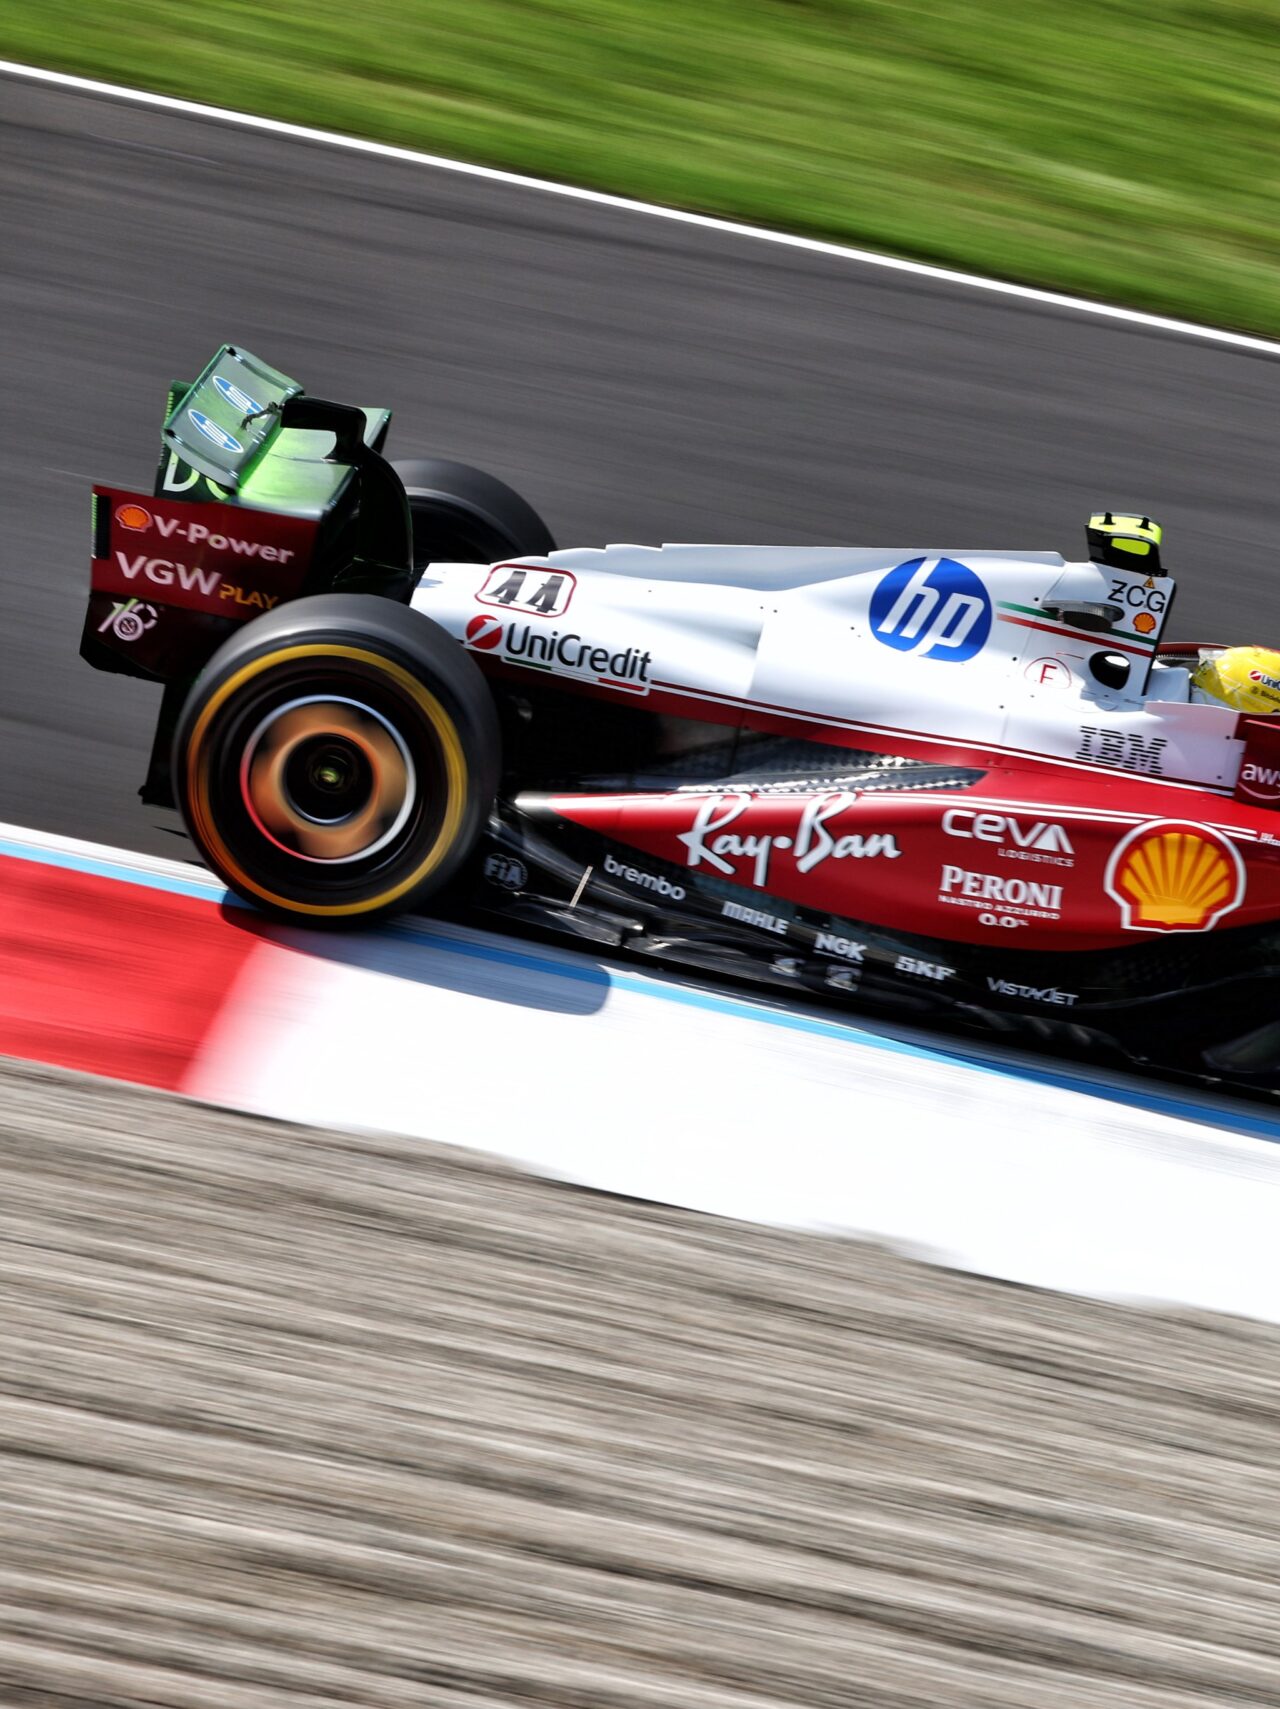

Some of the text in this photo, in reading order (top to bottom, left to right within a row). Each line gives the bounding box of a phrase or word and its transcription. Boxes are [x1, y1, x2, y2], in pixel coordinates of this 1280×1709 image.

[153, 514, 294, 564] V-Power
[115, 551, 279, 609] VGW PLAY
[490, 571, 564, 613] 44
[1107, 580, 1166, 613] ZCG
[876, 556, 985, 660] hp
[506, 623, 651, 682] UniCredit
[1075, 725, 1168, 775] IBM
[604, 854, 686, 900] brembo
[997, 848, 1074, 867] LOGISTICS
[938, 895, 994, 910] NASTRO
[939, 864, 1063, 909] PERONI
[721, 900, 788, 935] MAHLE
[814, 932, 867, 961] NGK
[895, 956, 956, 981] SKF
[986, 977, 1079, 1005] VISTAJET
